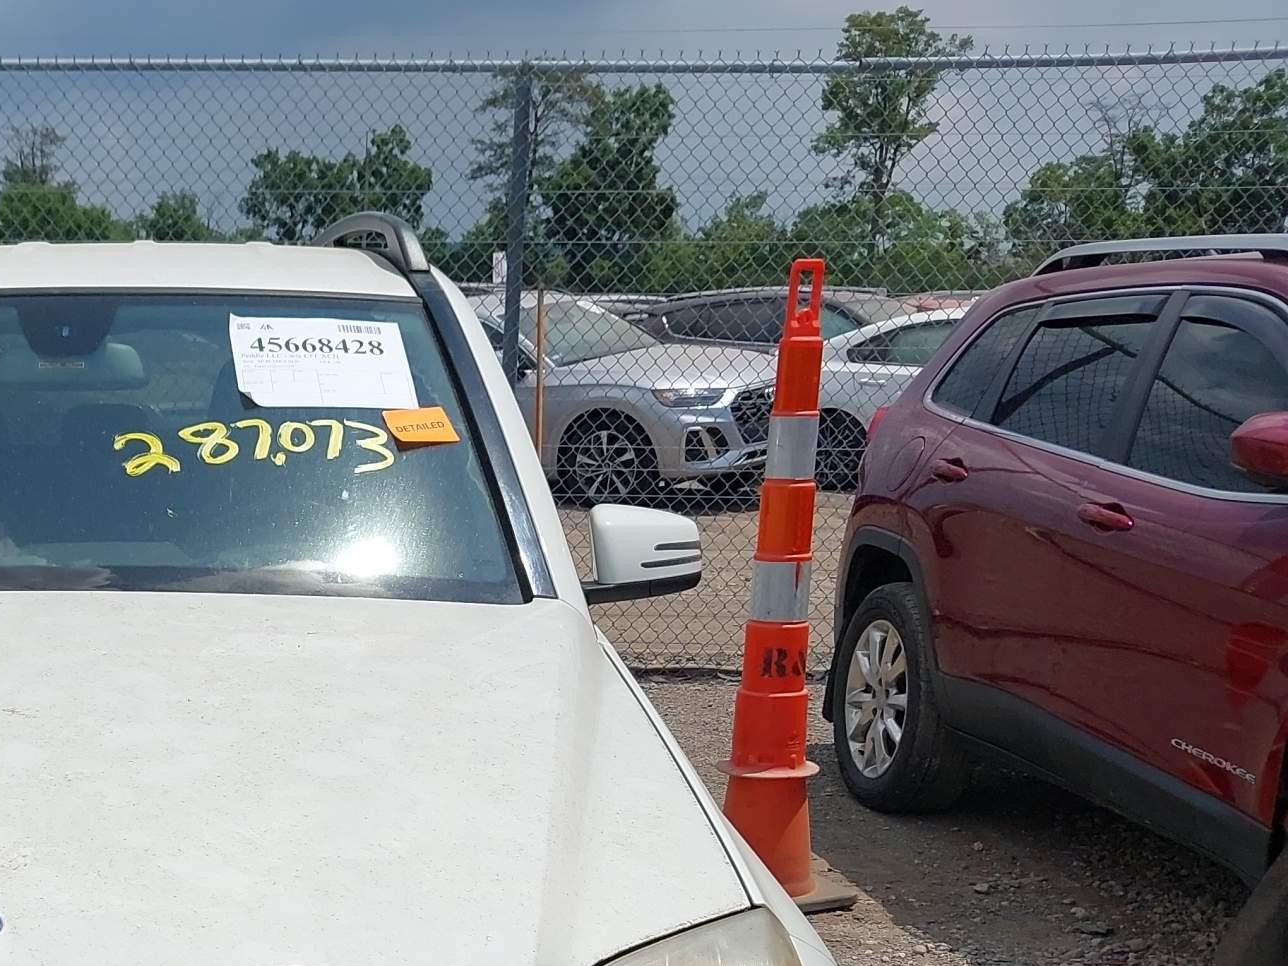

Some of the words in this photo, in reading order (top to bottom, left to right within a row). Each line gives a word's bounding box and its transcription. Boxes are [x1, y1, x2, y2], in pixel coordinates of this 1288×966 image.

[250, 336, 385, 356] 45668428
[395, 421, 445, 433] DETAILED
[1171, 738, 1256, 785] CHEROKEE
